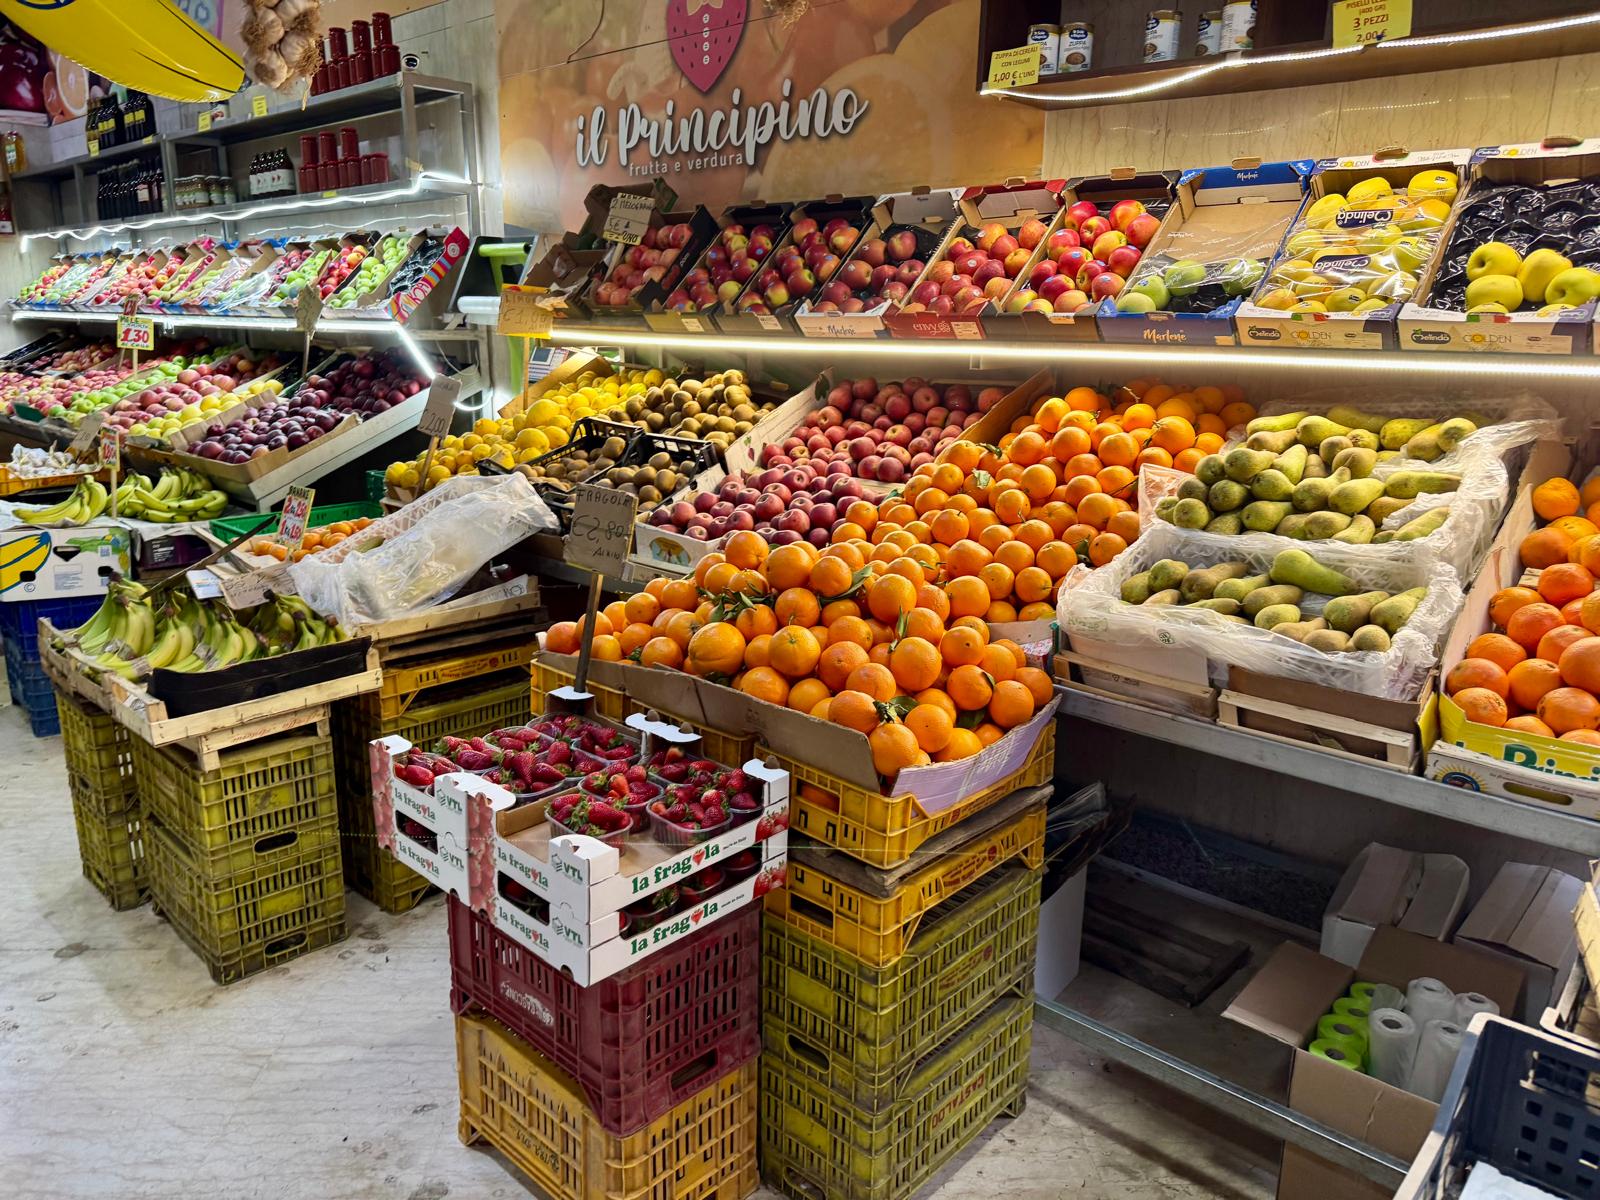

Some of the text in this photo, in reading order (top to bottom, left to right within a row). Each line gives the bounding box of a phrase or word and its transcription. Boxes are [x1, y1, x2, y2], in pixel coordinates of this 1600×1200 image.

[1346, 0, 1371, 10] PISELLI
[1353, 14, 1389, 28] 3 PEZZI
[1356, 31, 1378, 43] 2,00
[994, 52, 1013, 60] ZUPPA
[1018, 46, 1038, 56] CEREALI
[1013, 58, 1030, 66] LEGUMI
[993, 70, 1035, 83] 1,00 € L'UNO
[576, 78, 869, 167] il Principino
[629, 152, 744, 177] frutta e verdura
[1337, 210, 1393, 225] Melinda
[1315, 257, 1369, 271] Melinda
[913, 323, 938, 335] envy
[1143, 328, 1187, 344] Marlene
[1249, 330, 1332, 340] Melinda GOLDEN
[1412, 333, 1512, 343] Melinda GOLDEN
[394, 787, 403, 802] la
[446, 796, 463, 812] VTL
[399, 841, 407, 854] la
[498, 847, 507, 861] la
[449, 853, 464, 868] VTL
[563, 862, 583, 881] VTL
[632, 876, 650, 894] la
[499, 906, 508, 921] la
[564, 926, 583, 945] VTL
[630, 938, 649, 955] la
